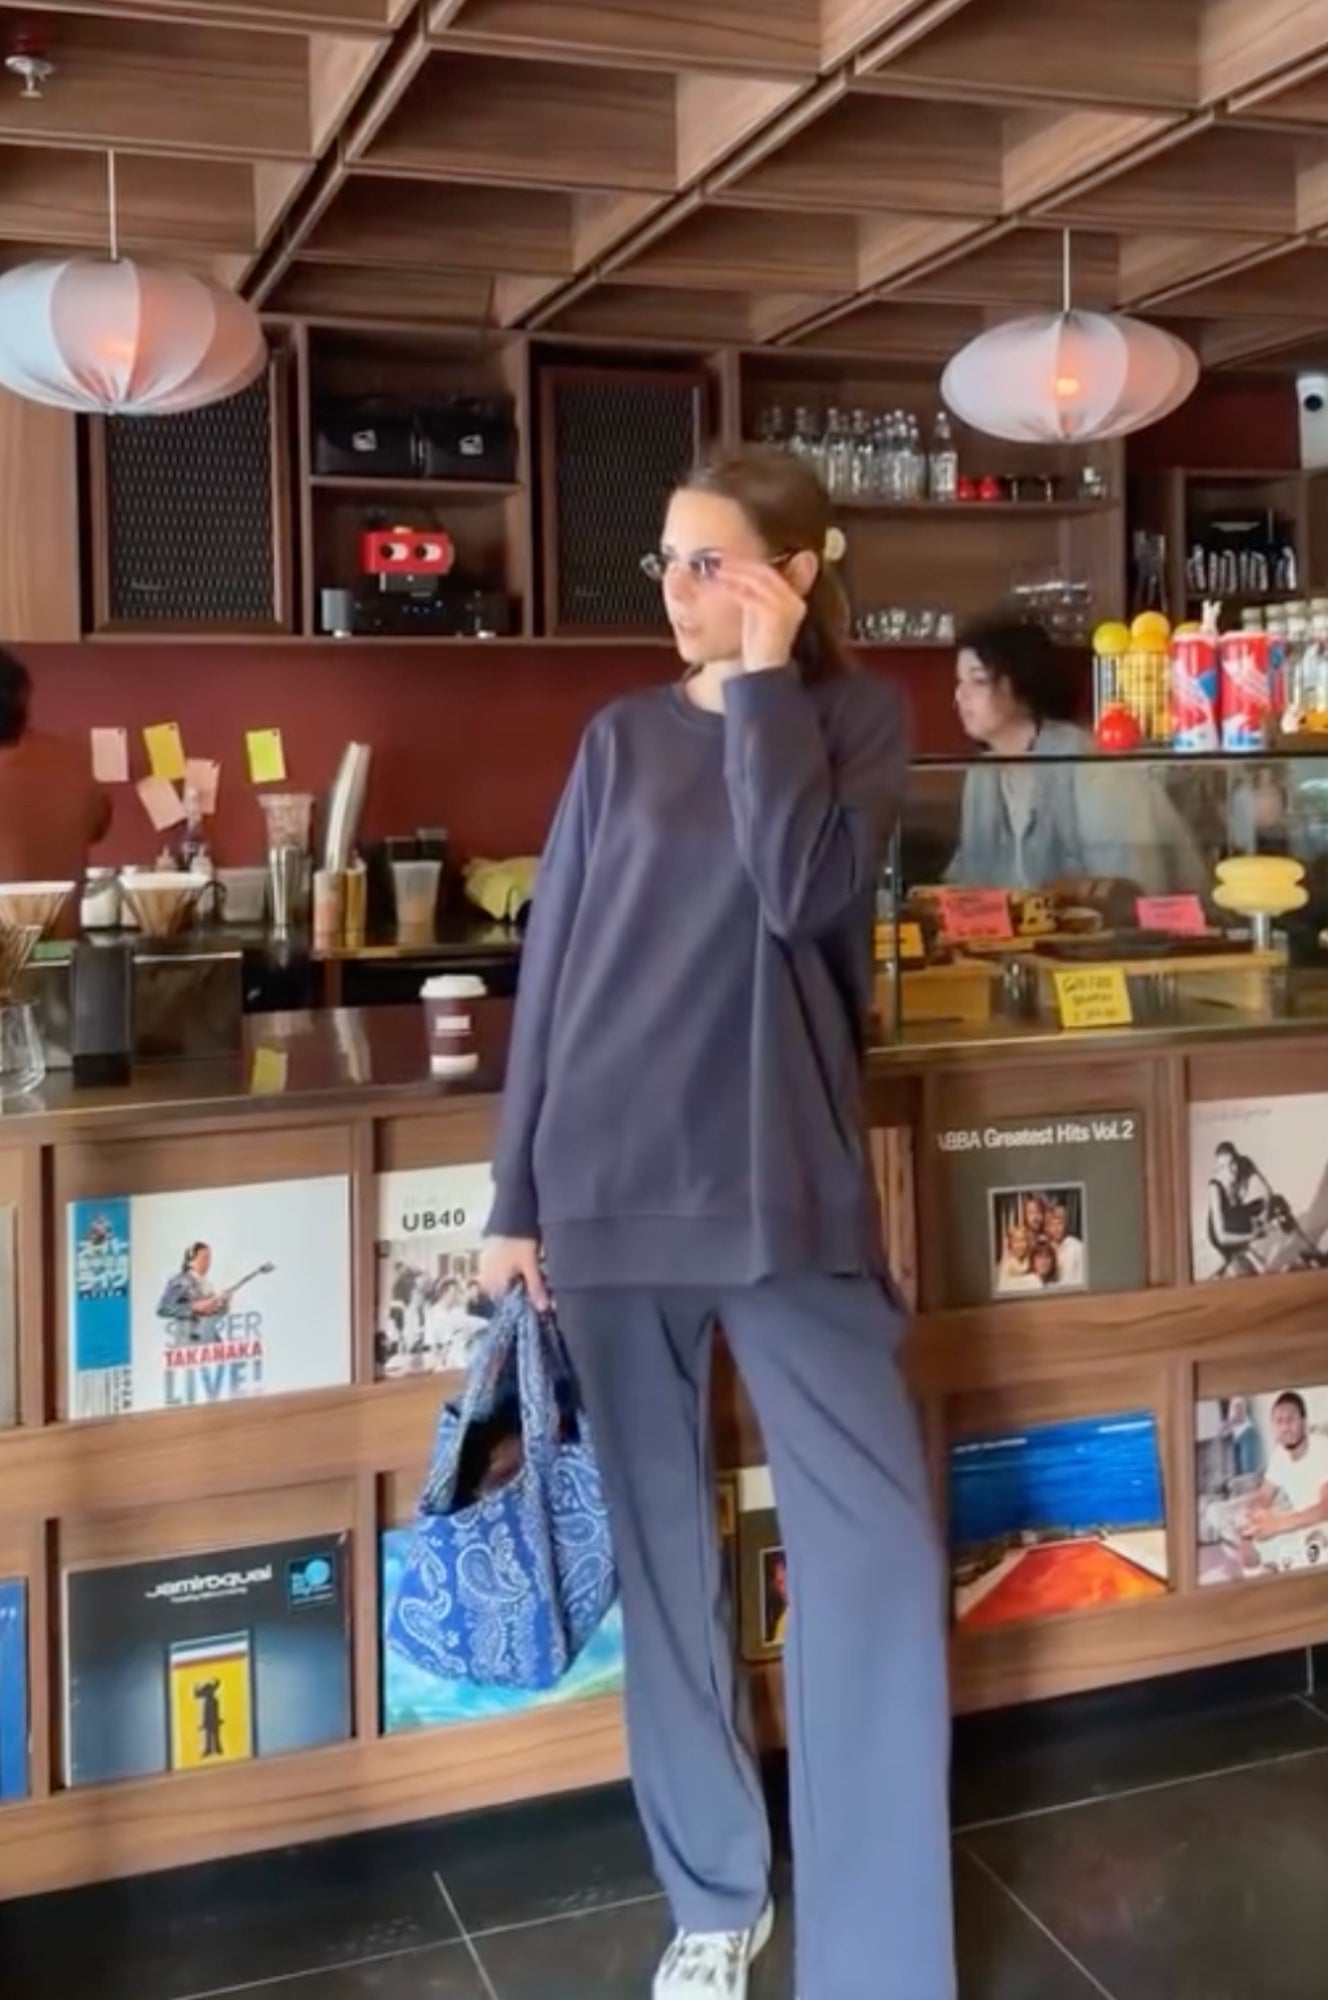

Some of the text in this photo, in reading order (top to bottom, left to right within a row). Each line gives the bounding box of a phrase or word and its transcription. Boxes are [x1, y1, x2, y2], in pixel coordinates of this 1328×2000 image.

[983, 1127, 1054, 1149] Greatest
[1057, 1122, 1090, 1144] Hits
[402, 1207, 466, 1233] UB40
[163, 1341, 263, 1368] TAKANAKA
[164, 1358, 263, 1405] LIVE!
